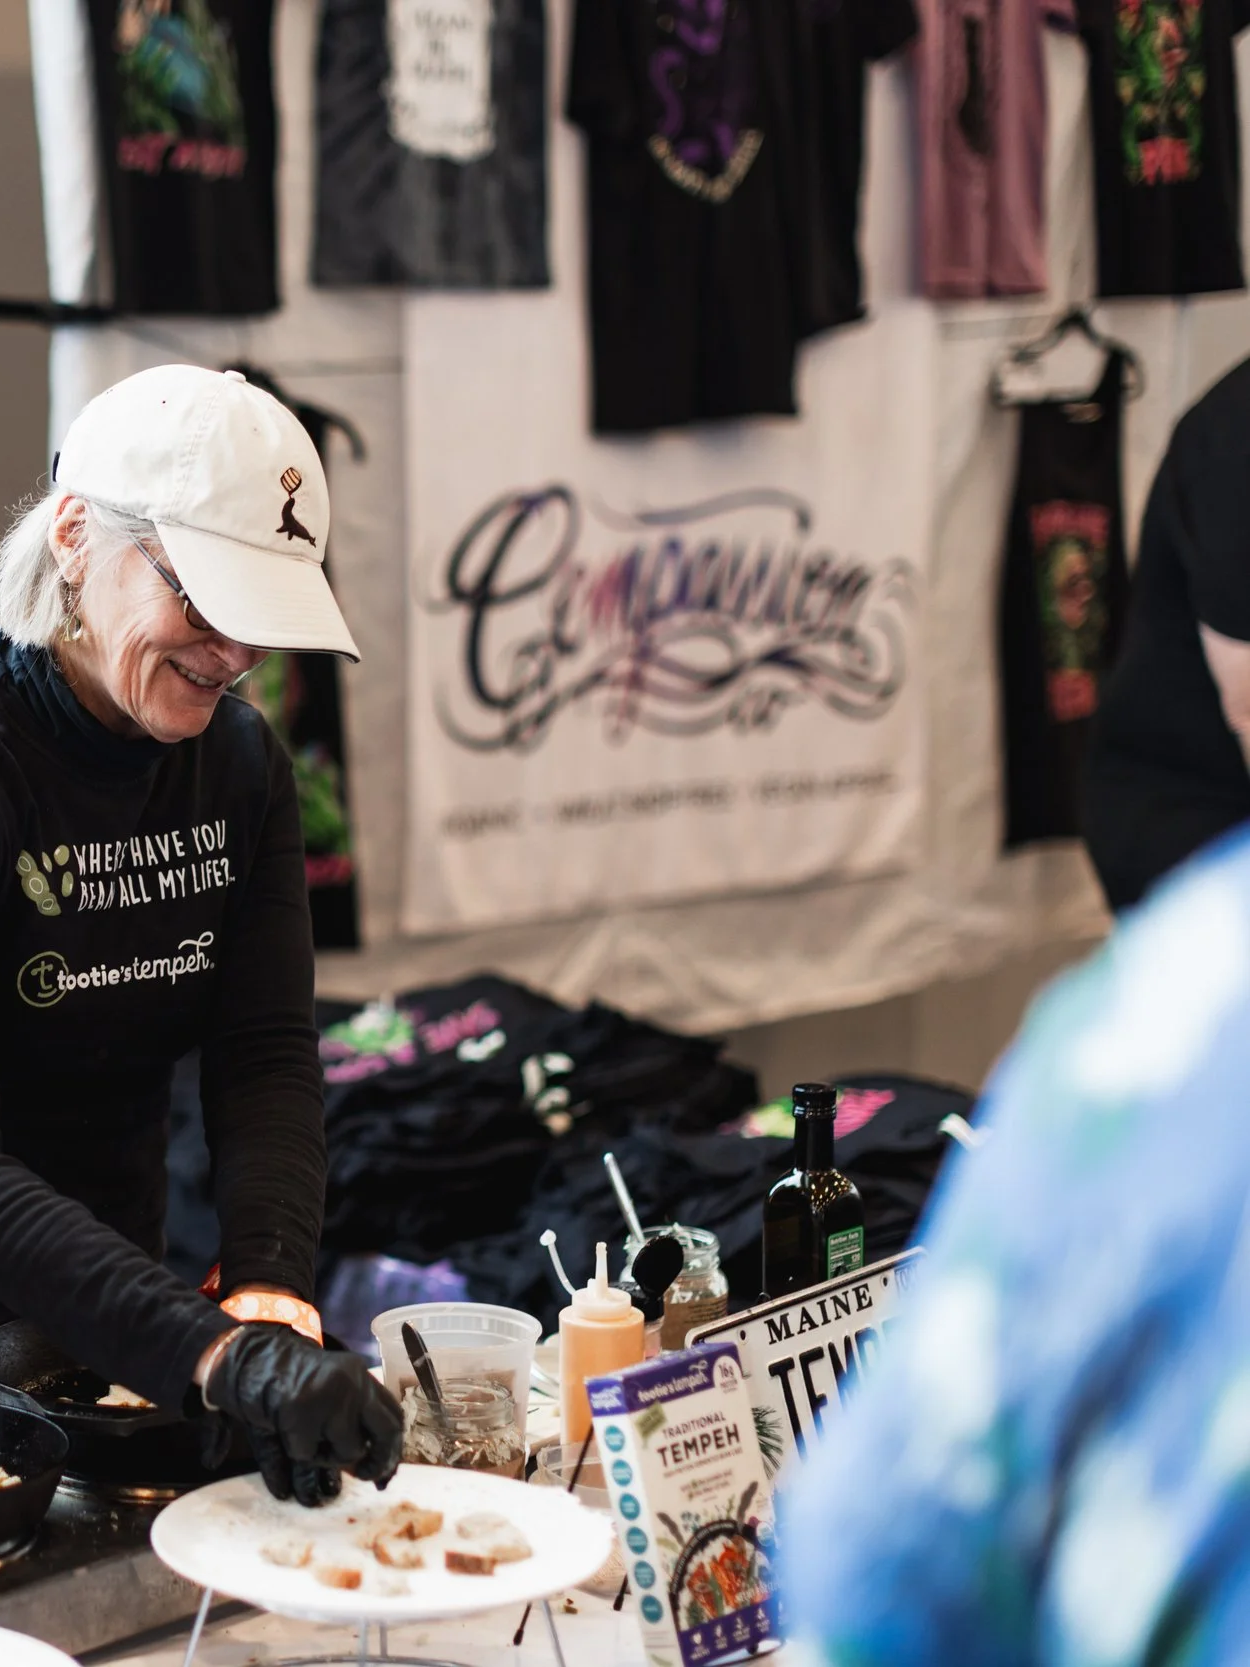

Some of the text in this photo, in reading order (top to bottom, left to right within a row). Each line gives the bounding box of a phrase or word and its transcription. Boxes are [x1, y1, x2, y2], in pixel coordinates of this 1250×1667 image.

[130, 830, 186, 867] HAVE
[192, 819, 226, 855] YOU
[118, 874, 152, 908] ALL
[158, 867, 186, 900] MY
[56, 963, 132, 991] tootie's
[764, 1283, 874, 1345] MAINE
[657, 1423, 740, 1468] TEMPEH
[662, 1411, 726, 1439] TRADITIONAL
